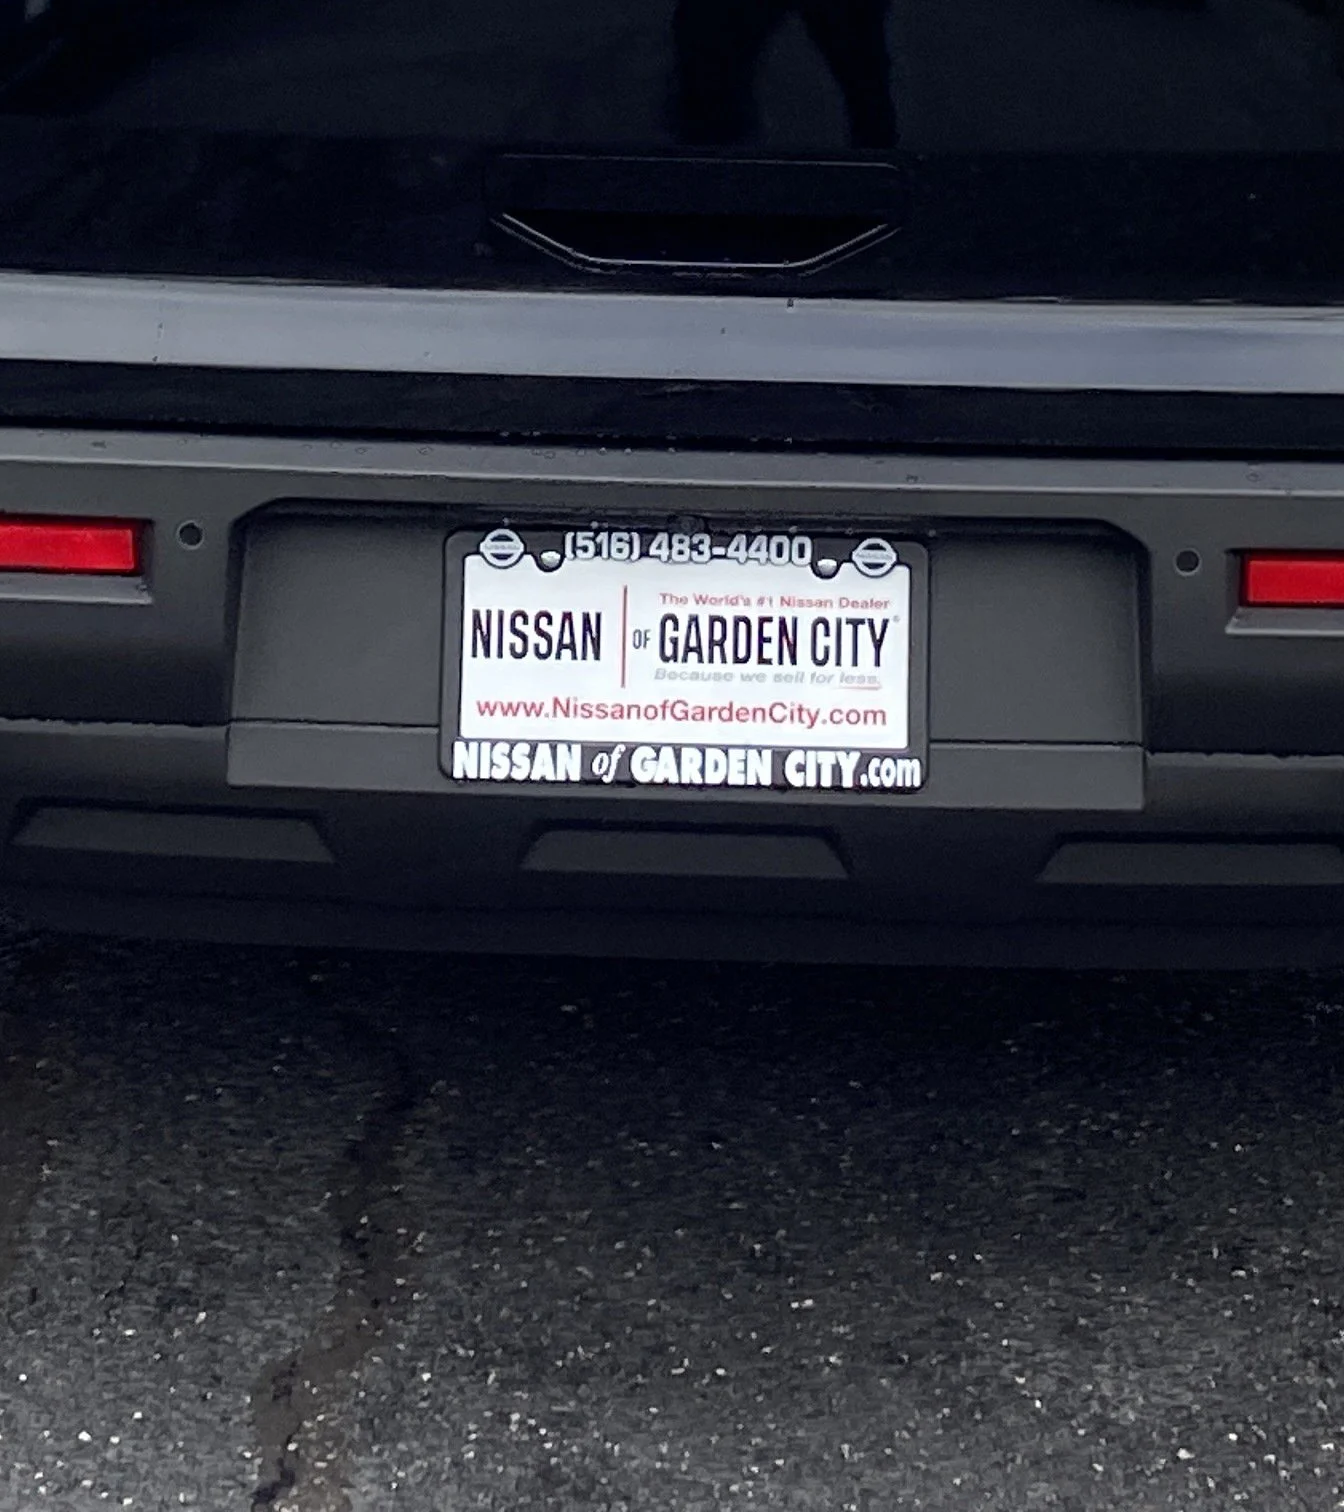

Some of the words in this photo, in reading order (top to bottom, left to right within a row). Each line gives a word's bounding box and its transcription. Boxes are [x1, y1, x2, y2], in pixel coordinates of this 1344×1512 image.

[564, 531, 641, 561] (516)
[649, 532, 813, 567] 483-4400
[659, 592, 689, 606] The
[692, 594, 751, 607] World's
[756, 595, 774, 608] #1
[779, 595, 834, 609] Nissan
[839, 597, 891, 609] Dealer
[471, 608, 602, 661] NISSAN
[632, 628, 651, 650] OF
[658, 612, 798, 666] GARDEN
[810, 616, 889, 667] CITY
[654, 668, 734, 683] Because
[740, 671, 767, 683] we
[773, 671, 805, 684] sell
[810, 671, 834, 685] for
[476, 696, 887, 729] www.NissanofGardenCity.com
[452, 740, 582, 782] NISSAN
[591, 743, 626, 784] of
[630, 745, 773, 786] GARDEN
[784, 749, 922, 788] CITY.com
